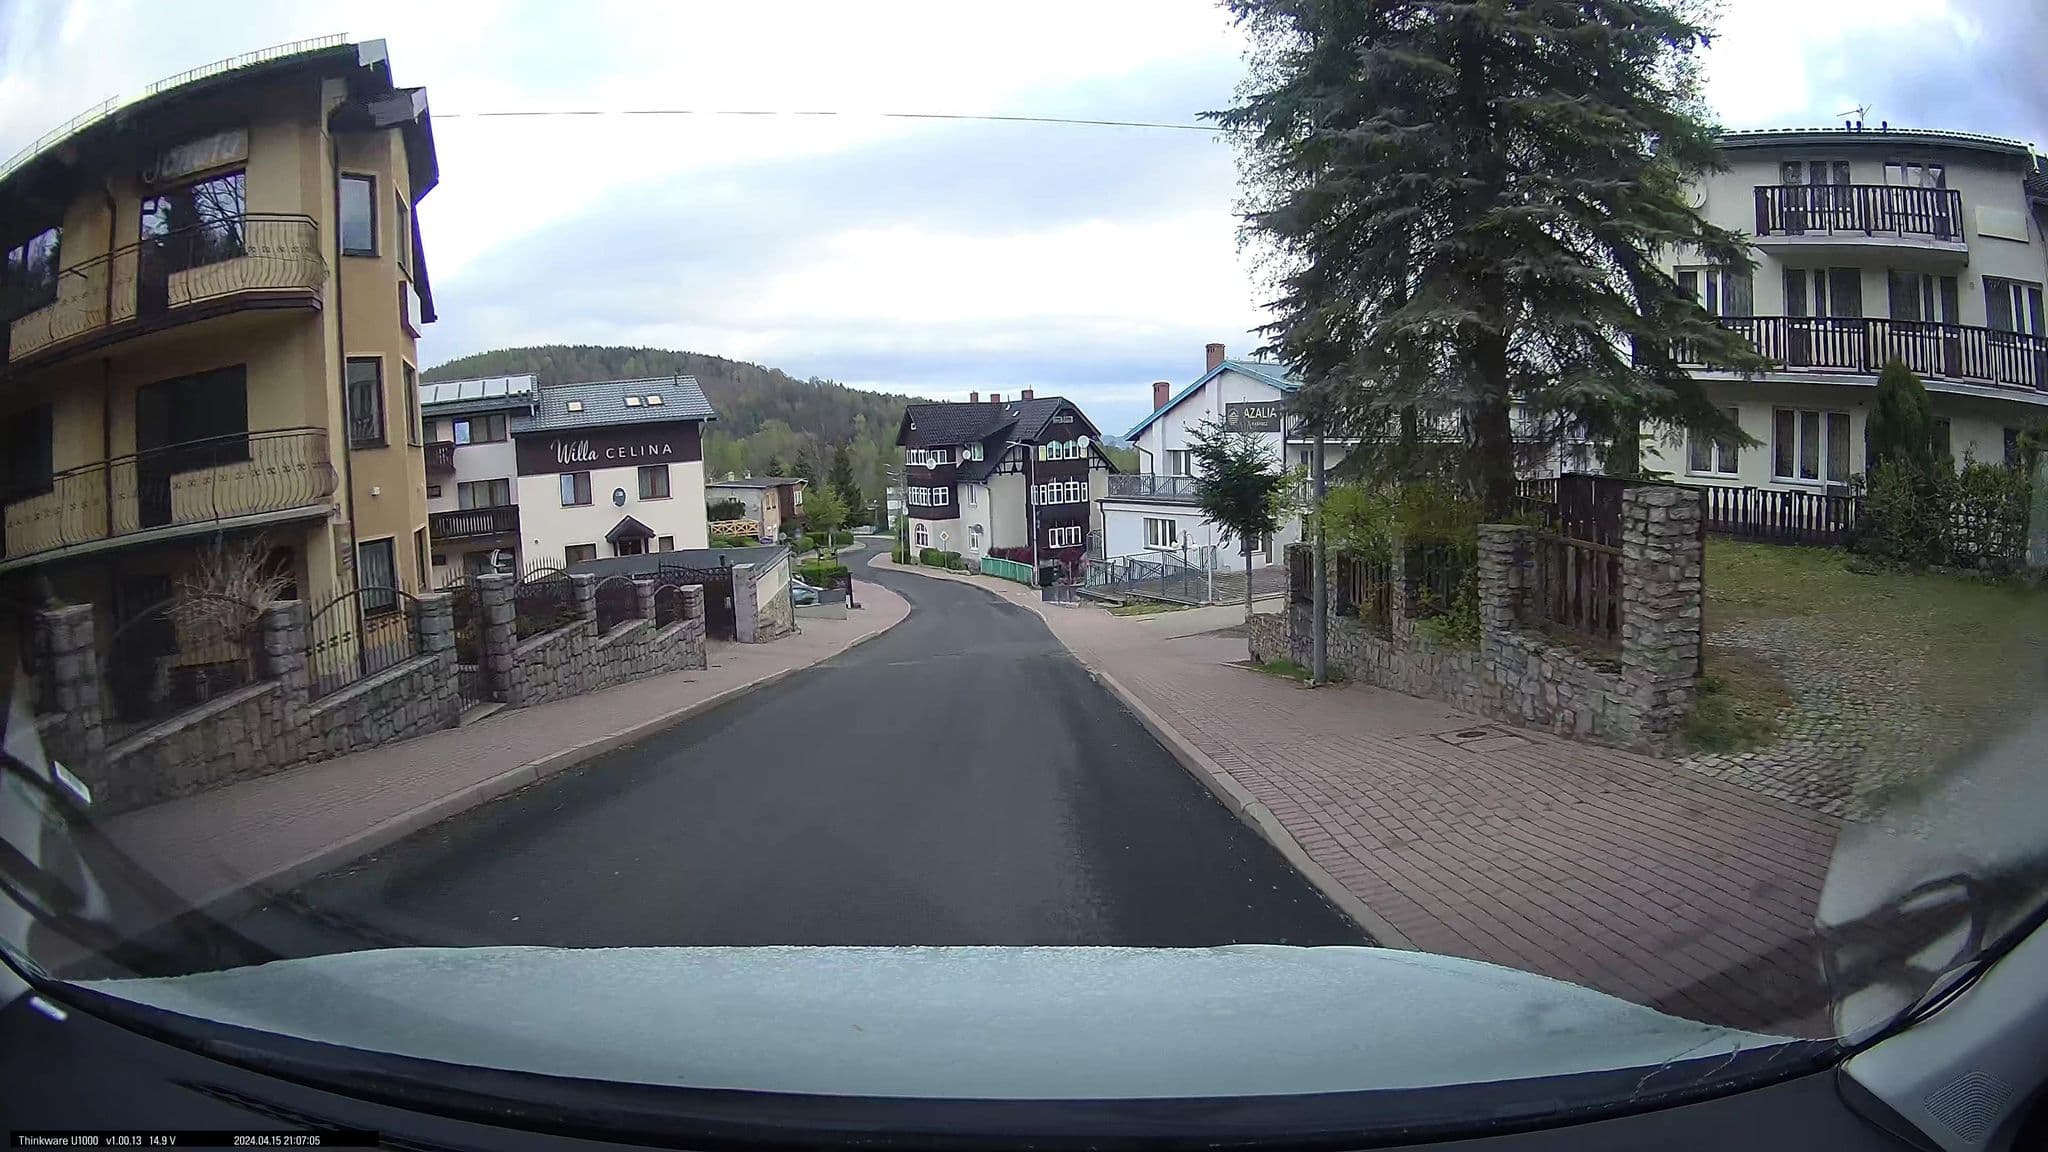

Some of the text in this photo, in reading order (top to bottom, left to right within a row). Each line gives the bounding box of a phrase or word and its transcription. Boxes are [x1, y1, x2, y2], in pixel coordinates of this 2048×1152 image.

[1244, 407, 1277, 418] AZALIA
[550, 439, 672, 464] Willa CELINA
